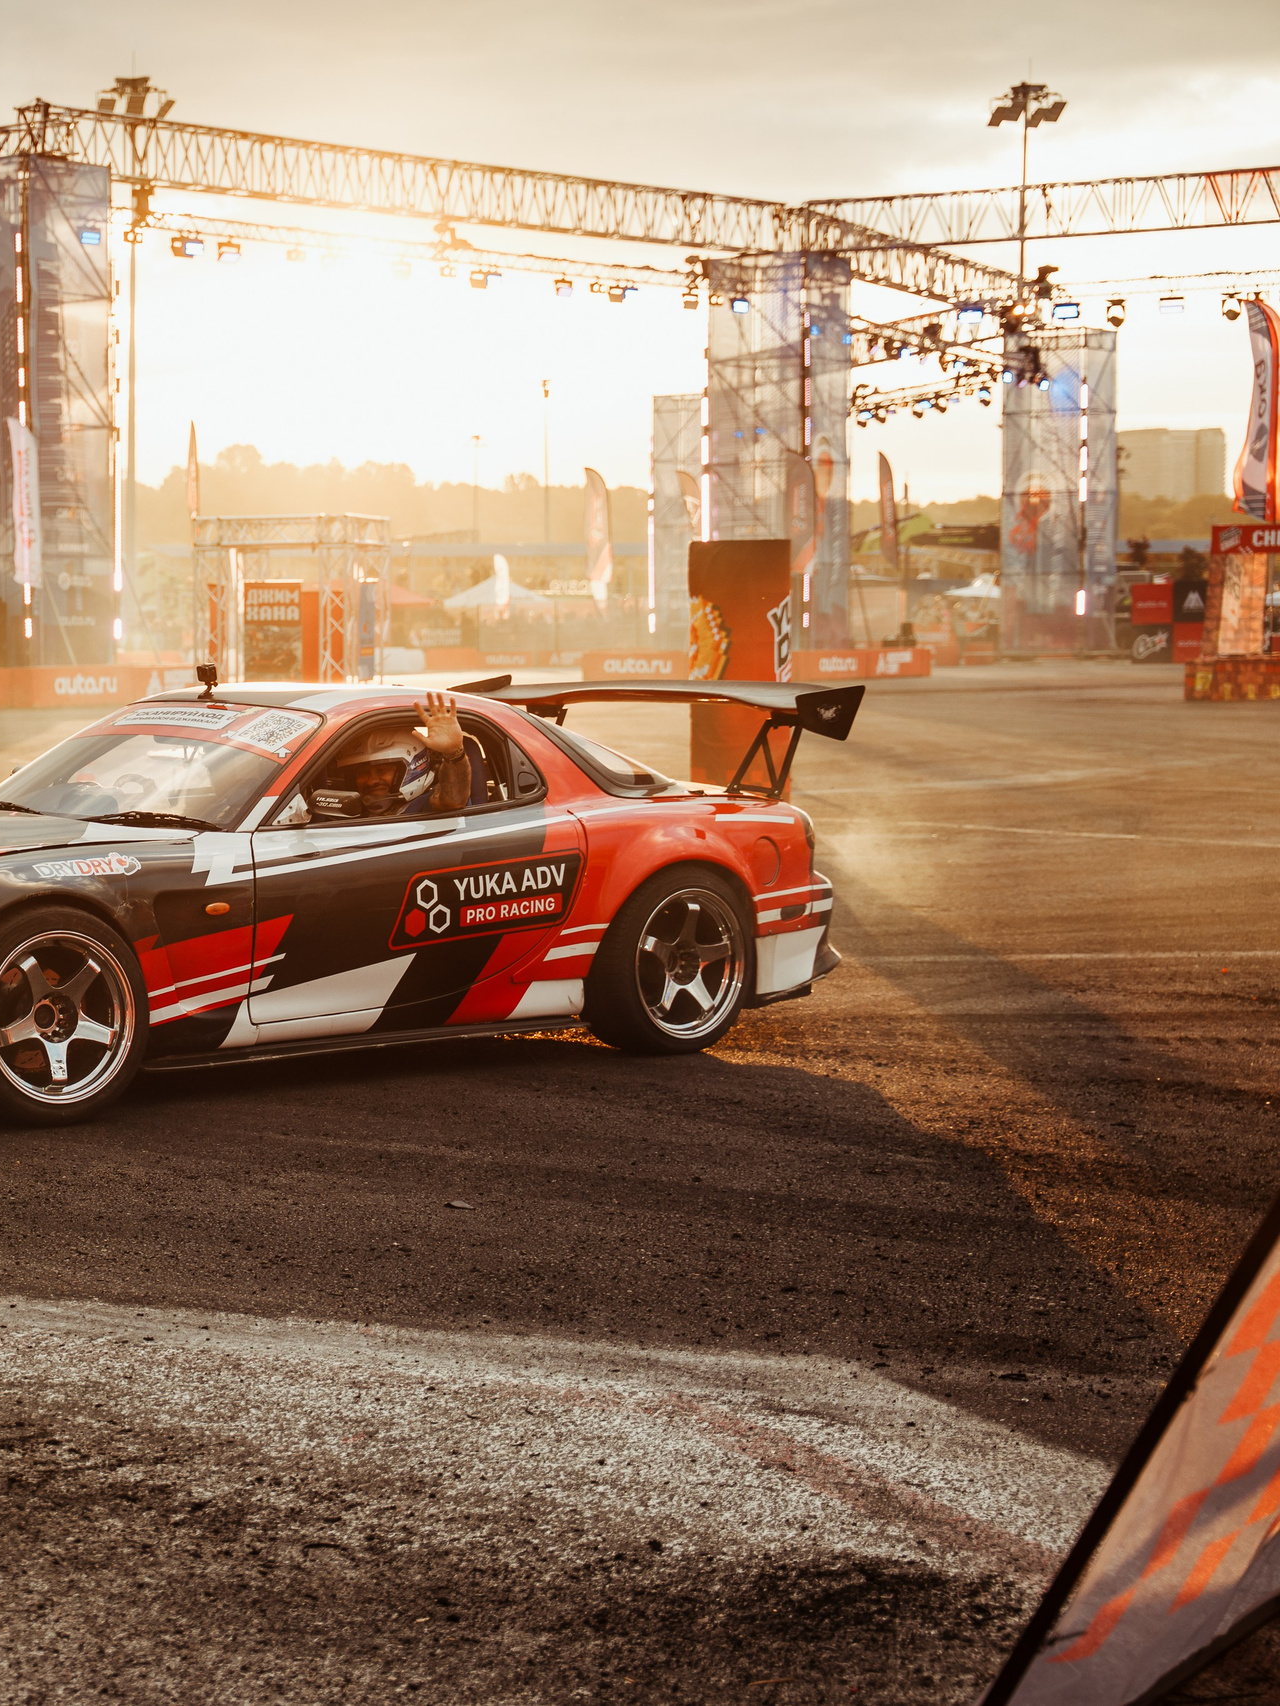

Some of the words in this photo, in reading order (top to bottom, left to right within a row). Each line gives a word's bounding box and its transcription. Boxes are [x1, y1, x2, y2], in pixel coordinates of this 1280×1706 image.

[246, 588, 300, 605] ДЖИМ
[246, 605, 300, 621] ХАНА
[603, 658, 672, 675] auto.ru
[54, 674, 118, 695] auto.ru
[197, 711, 226, 720] КОД
[453, 871, 517, 901] YUKA
[521, 863, 566, 892] ADV
[466, 906, 496, 924] PRO
[500, 897, 556, 918] RACING
